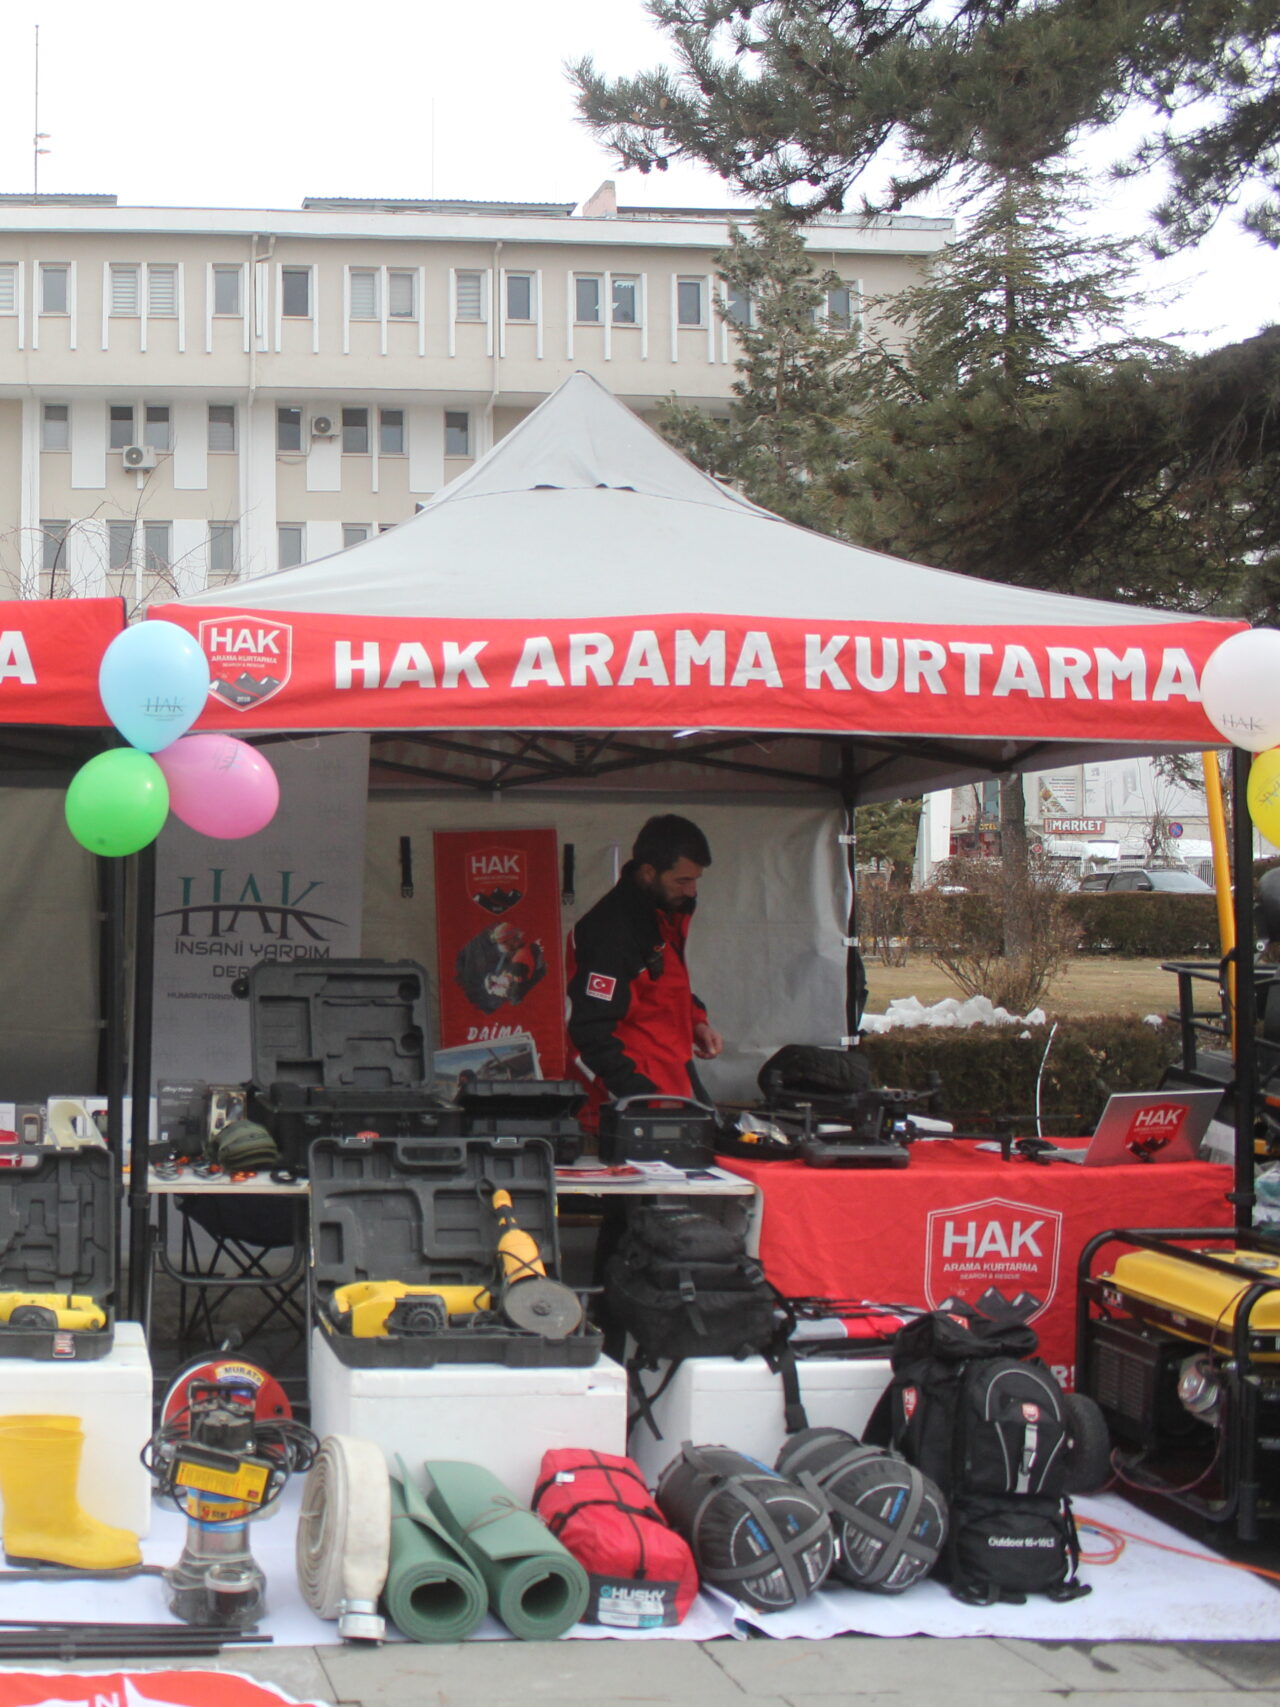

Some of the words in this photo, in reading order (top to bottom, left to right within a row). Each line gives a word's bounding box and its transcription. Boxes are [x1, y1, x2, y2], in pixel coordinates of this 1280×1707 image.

[210, 627, 281, 654] HAK
[334, 640, 490, 689] HAK
[510, 629, 784, 688] ARAMA
[804, 634, 1203, 703] KURTARMA
[146, 696, 183, 713] HAK
[1051, 820, 1103, 832] MARKET
[471, 855, 521, 874] HAK
[177, 868, 331, 942] HAK
[175, 937, 243, 957] İNSANİ
[213, 965, 250, 978] DER
[467, 1022, 523, 1041] DAİMA
[1135, 1108, 1183, 1126] HAK
[942, 1220, 1046, 1258] HAK
[943, 1262, 981, 1273] ARAMA
[983, 1263, 1038, 1273] KURTARMA
[988, 1536, 1023, 1548] Outdoor
[611, 1586, 666, 1602] HUSKY
